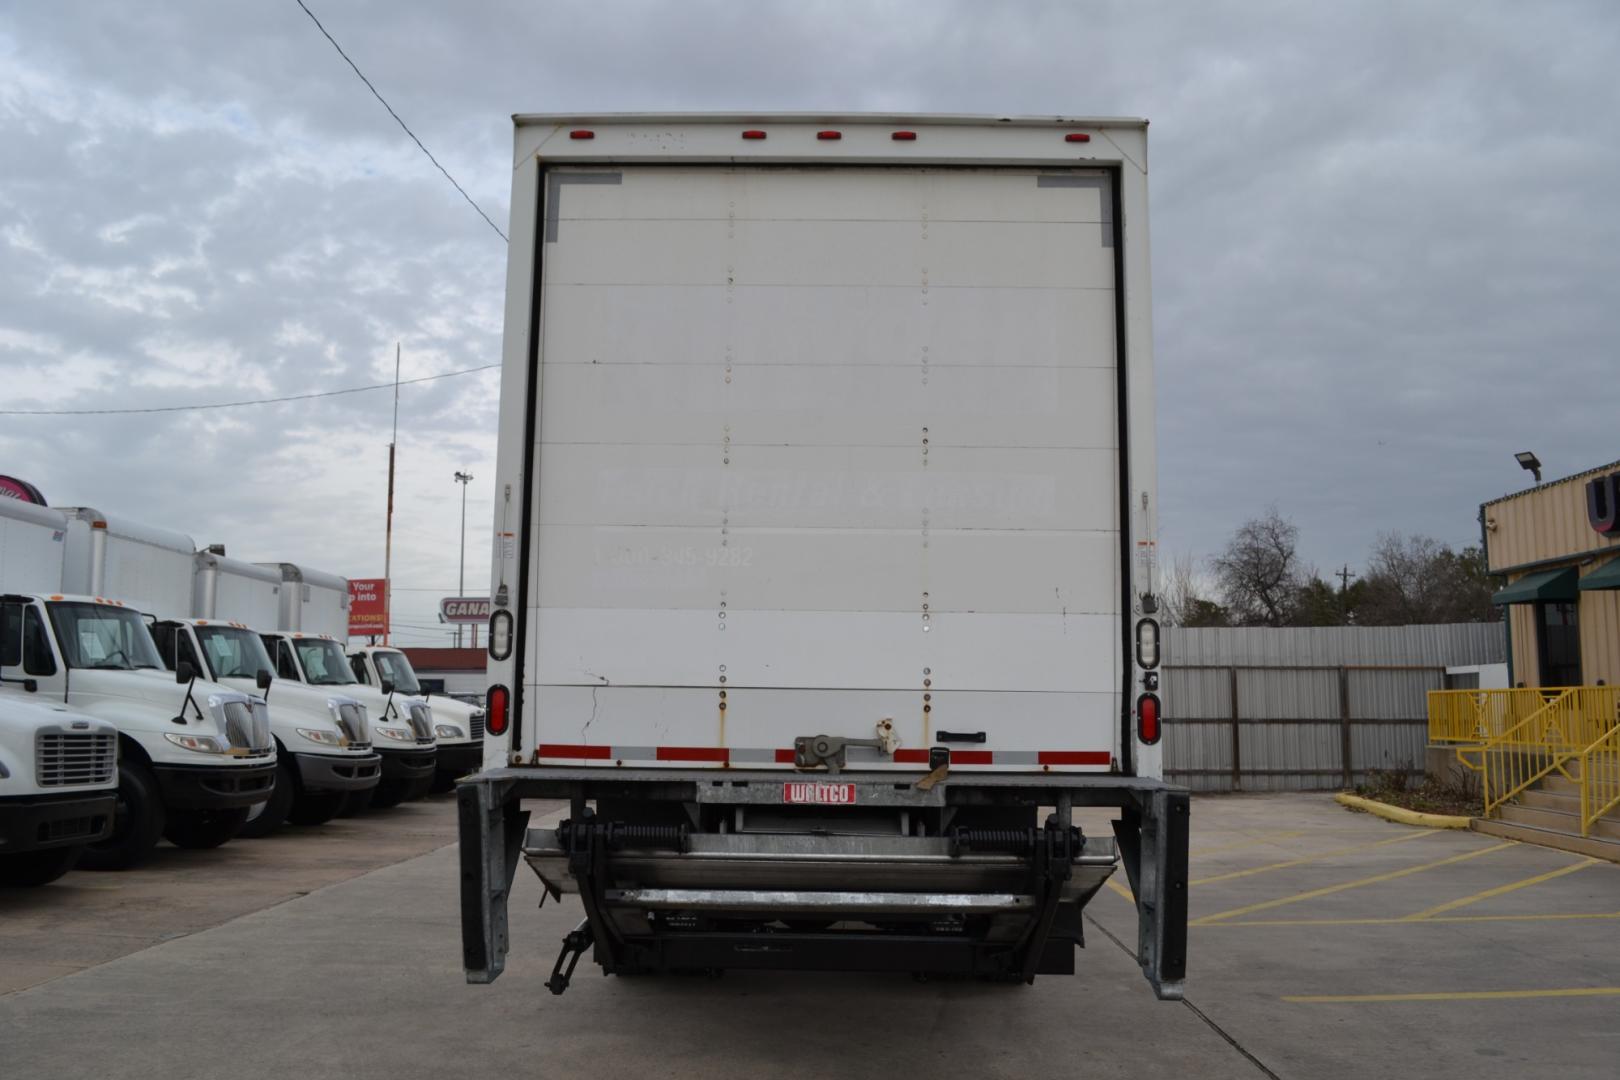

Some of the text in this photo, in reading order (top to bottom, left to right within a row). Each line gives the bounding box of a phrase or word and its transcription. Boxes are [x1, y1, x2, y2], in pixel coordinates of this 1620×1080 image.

[353, 582, 375, 591] Your
[357, 592, 377, 601] into
[446, 602, 489, 616] GANA
[790, 783, 849, 802] WALTCO
